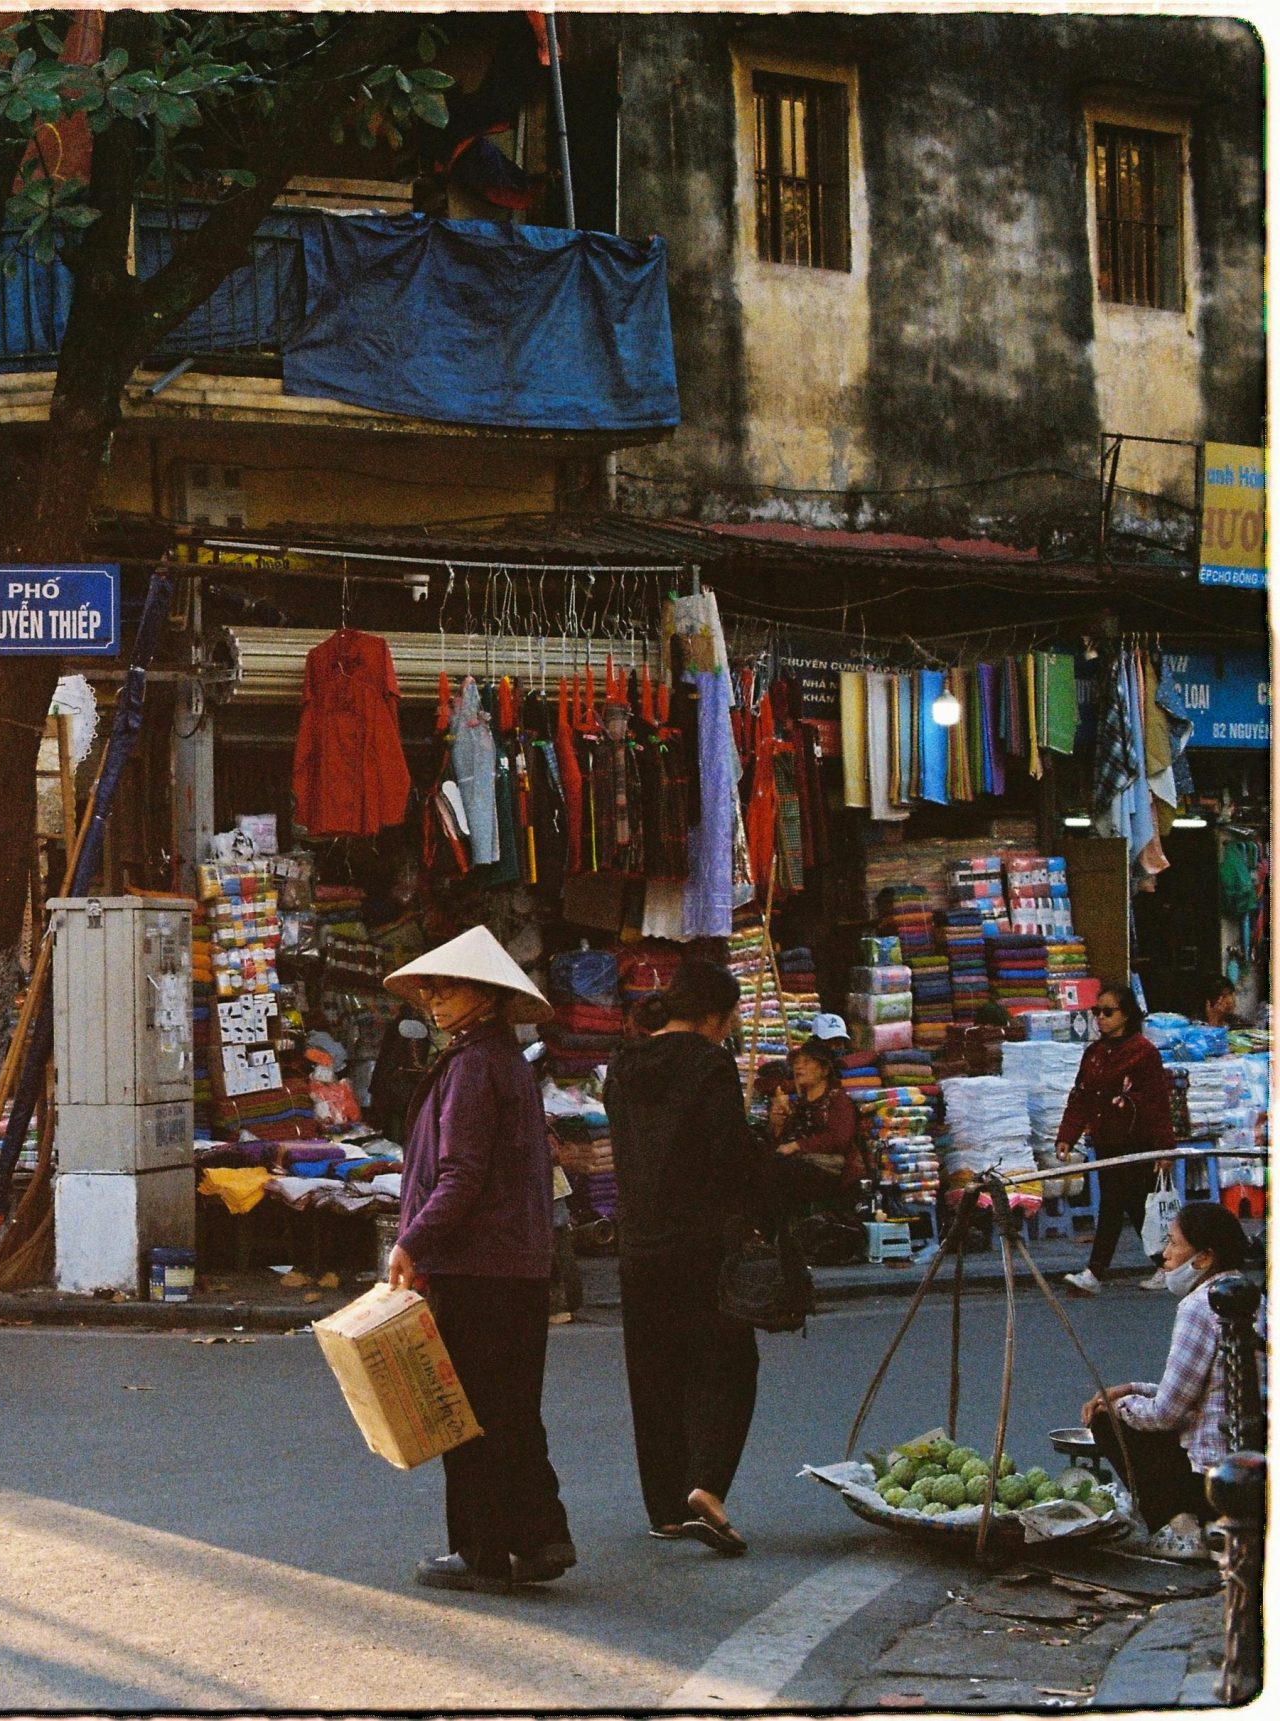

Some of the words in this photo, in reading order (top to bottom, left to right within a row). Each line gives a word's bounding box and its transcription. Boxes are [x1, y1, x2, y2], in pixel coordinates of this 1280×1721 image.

[8, 577, 61, 599] PHỐ
[48, 602, 101, 640] THIẾP
[1184, 683, 1210, 715] LOẠI
